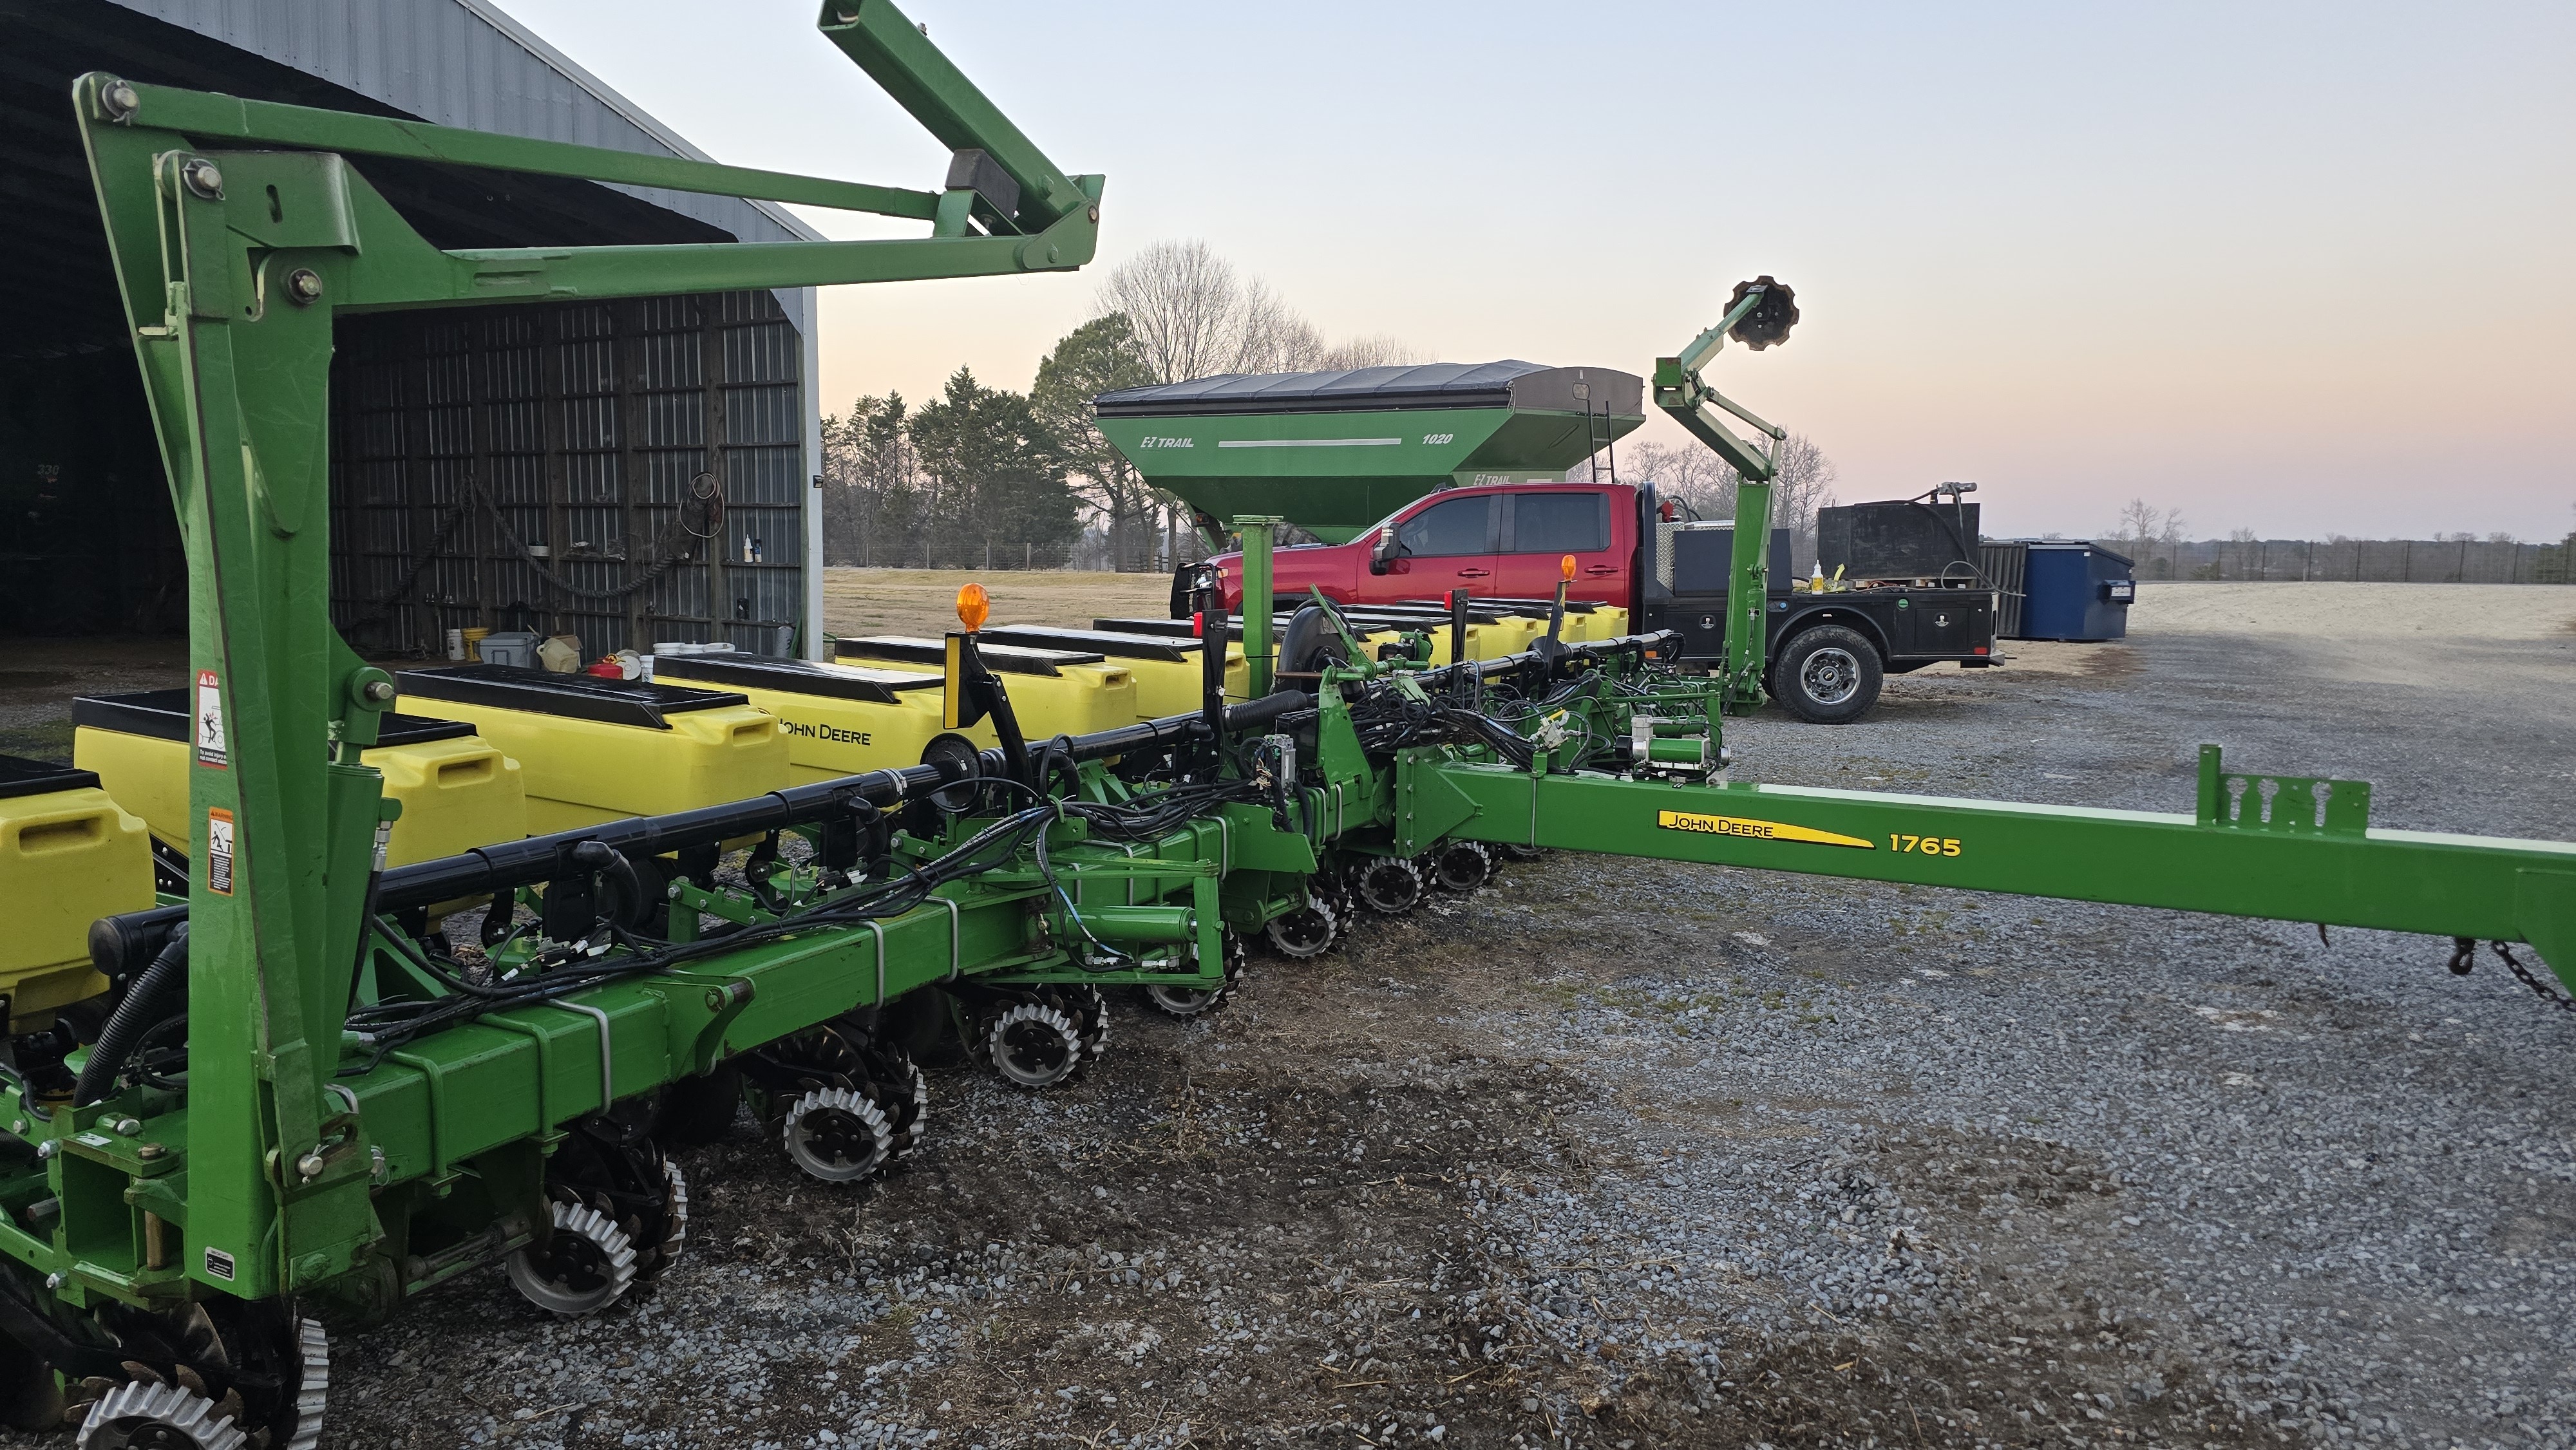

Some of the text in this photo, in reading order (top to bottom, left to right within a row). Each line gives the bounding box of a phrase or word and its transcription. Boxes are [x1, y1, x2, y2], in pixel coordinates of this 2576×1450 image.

[1140, 437, 1195, 448] E-Z TRAIL
[1423, 433, 1454, 444] 1020
[1485, 475, 1511, 485] TRAIL
[819, 724, 871, 746] DEERE
[1669, 814, 1774, 837] JOHN DEERE
[1890, 834, 1961, 856] 1765
